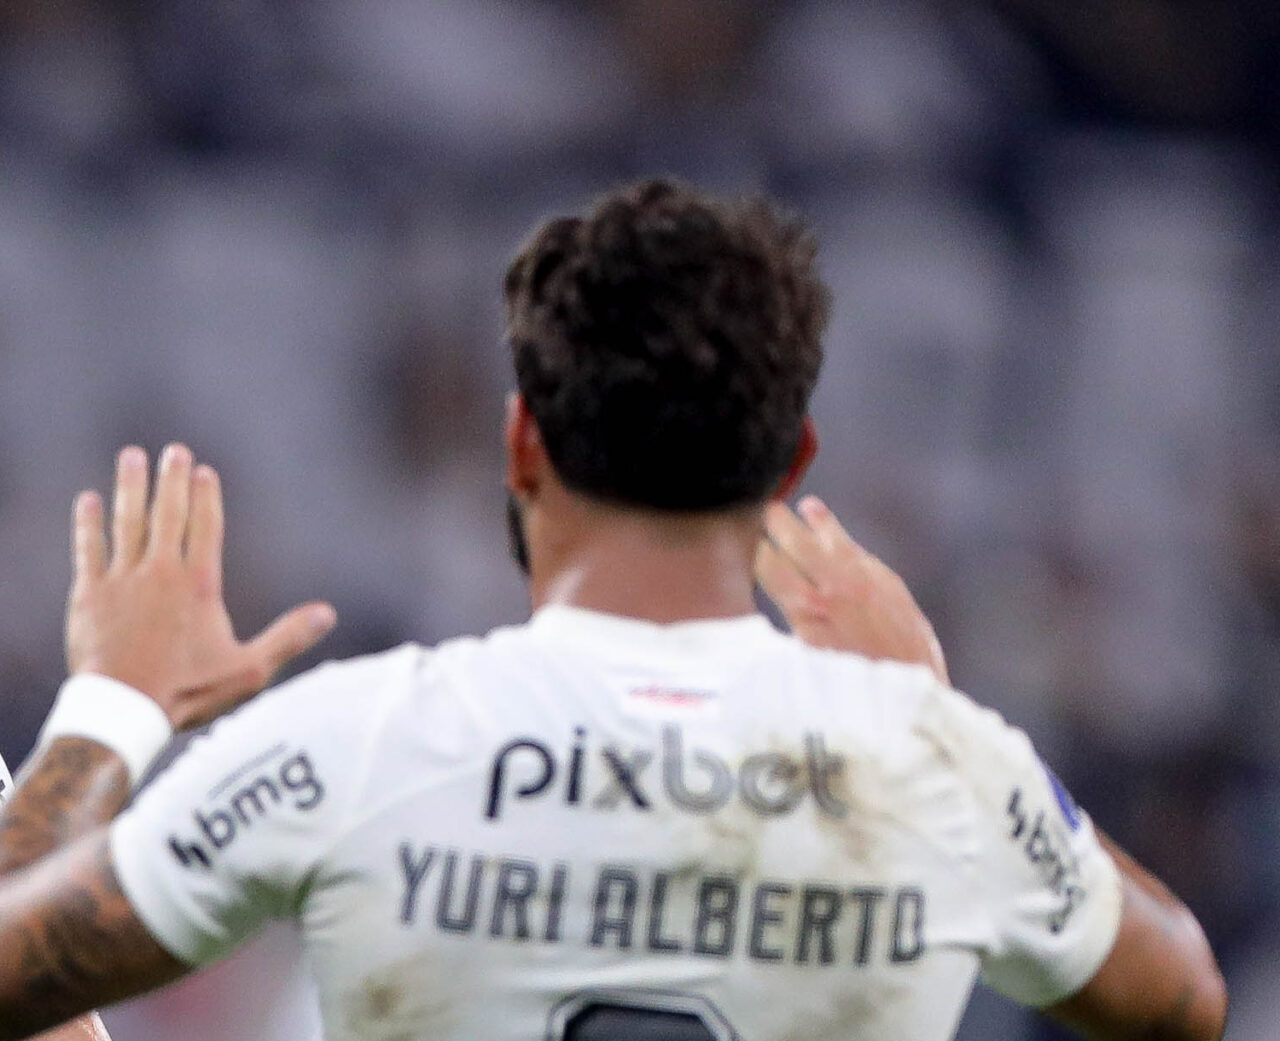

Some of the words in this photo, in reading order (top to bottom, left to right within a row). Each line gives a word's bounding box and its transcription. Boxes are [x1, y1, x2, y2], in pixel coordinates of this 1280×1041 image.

[193, 750, 324, 850] bmg
[483, 724, 850, 820] pixbet
[398, 840, 569, 943] YURI
[590, 863, 926, 968] ALBERTO
